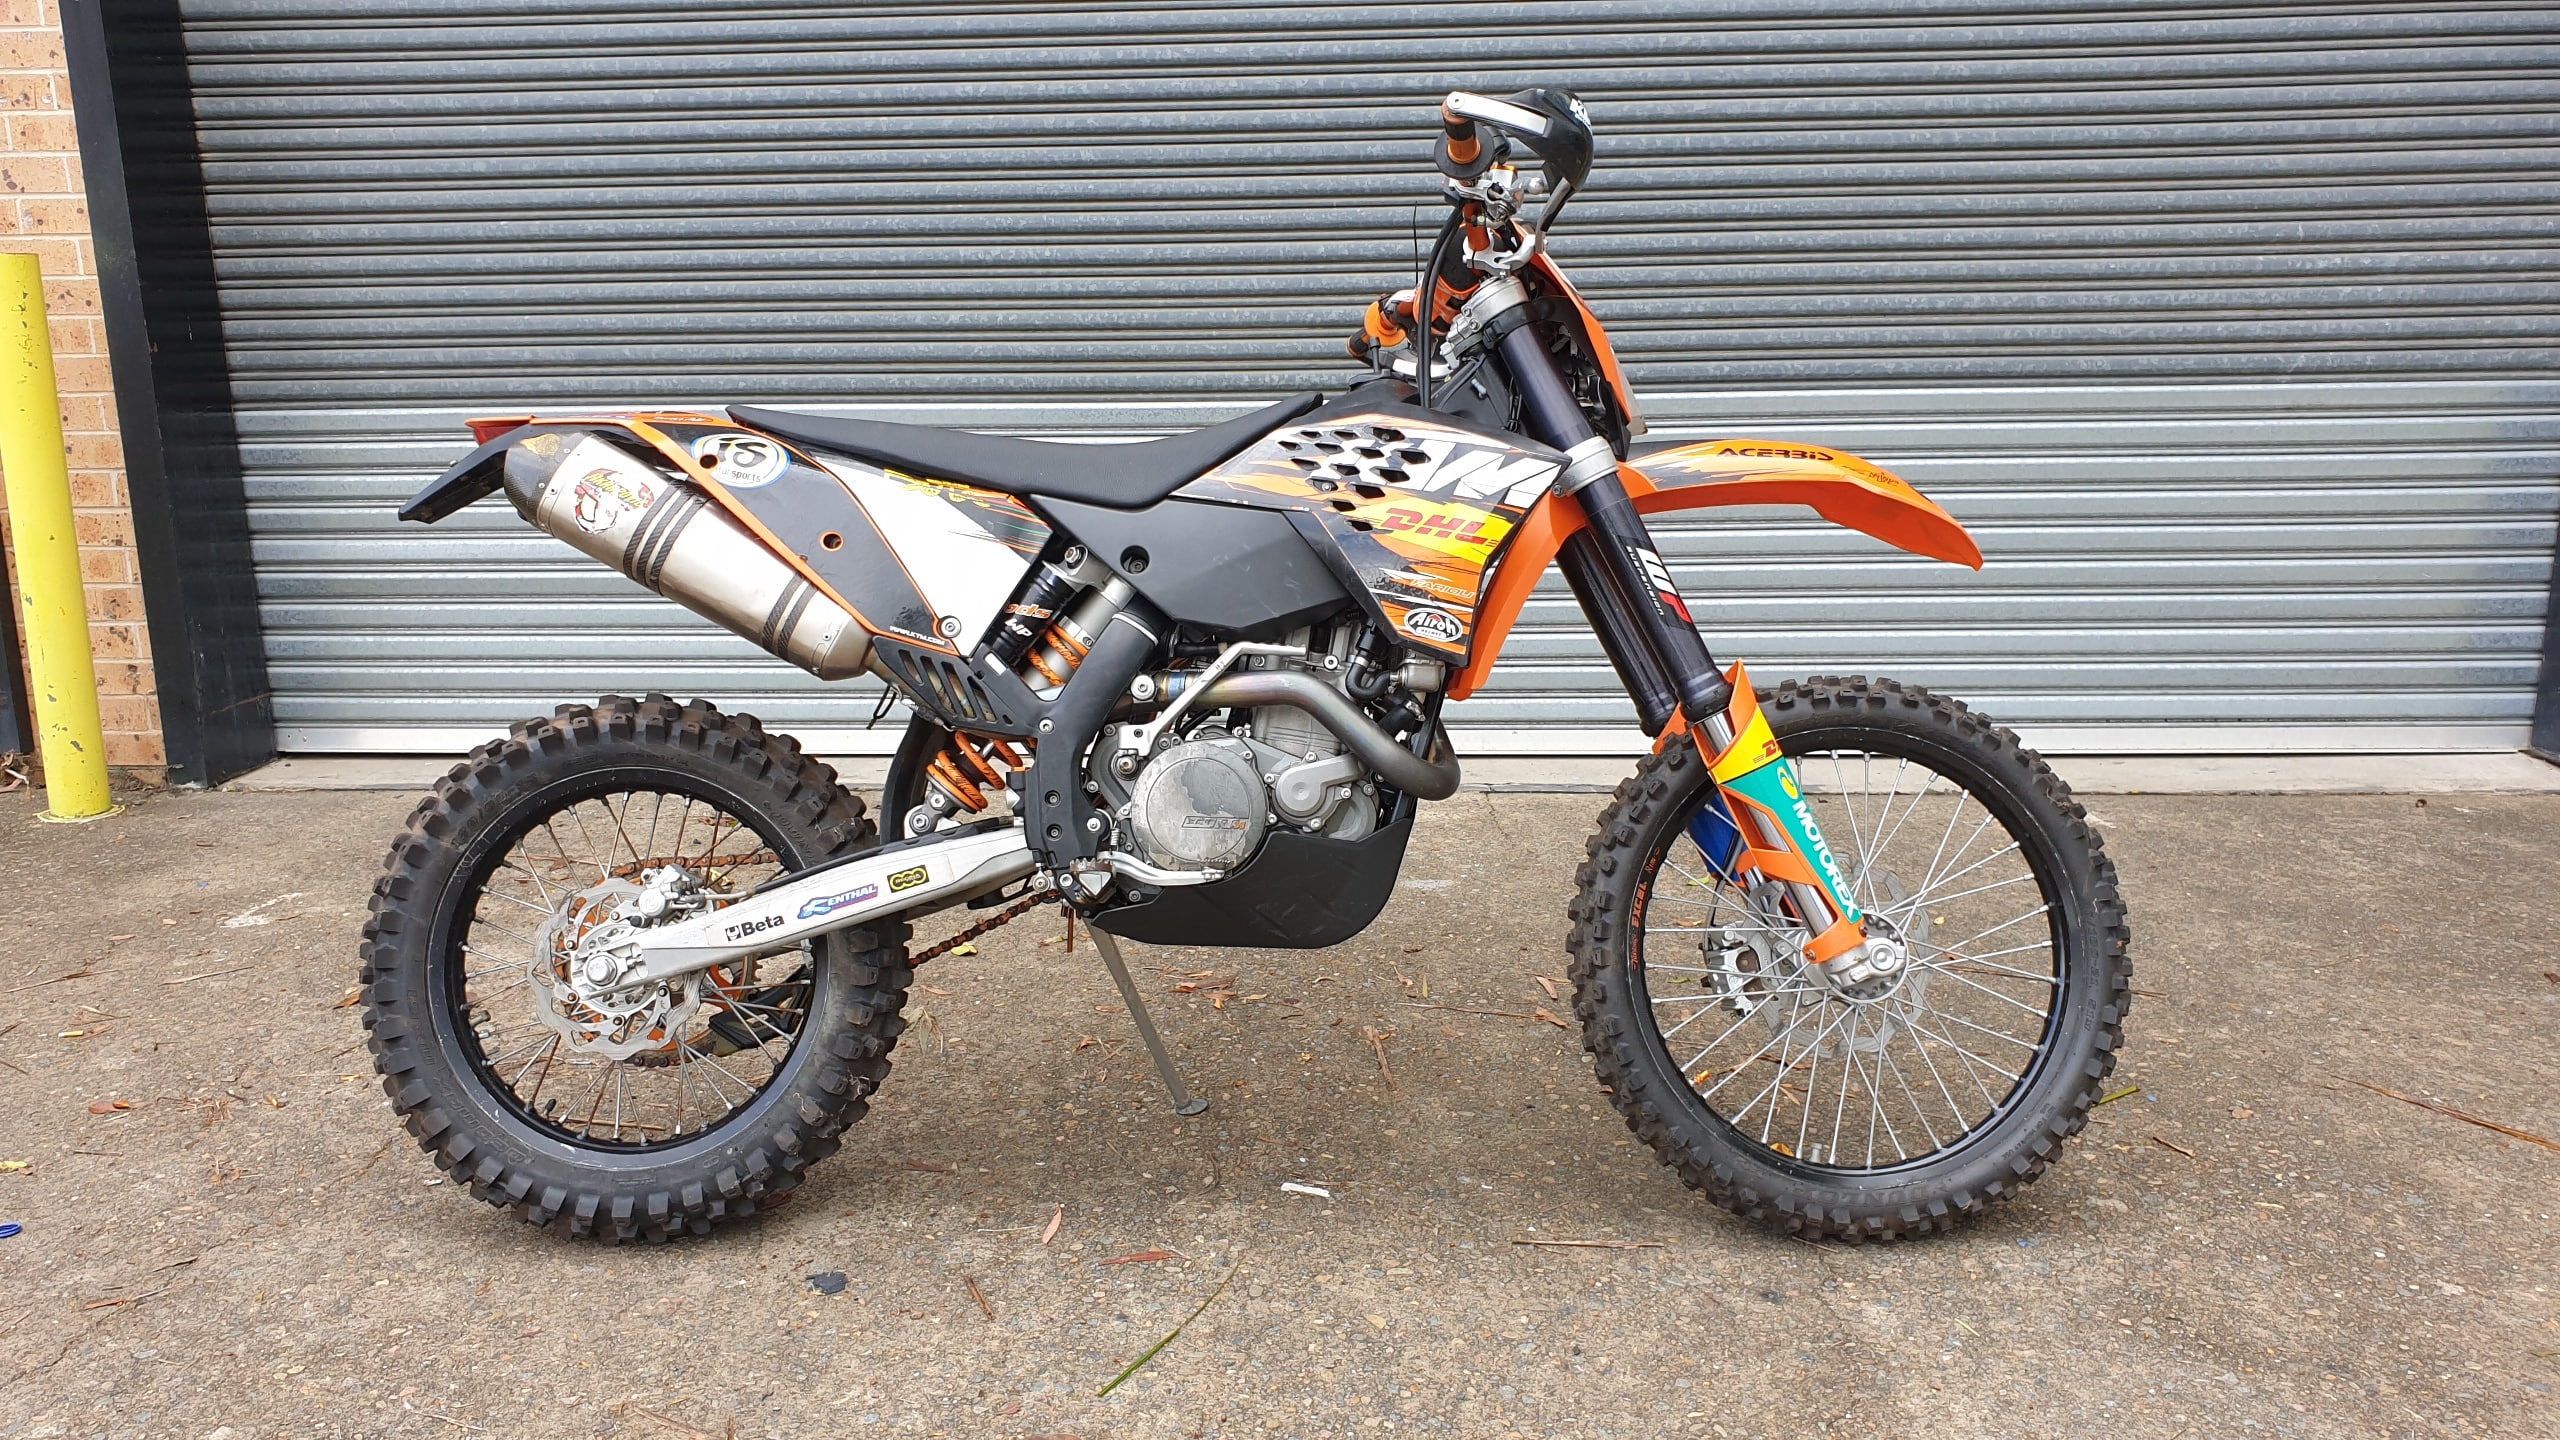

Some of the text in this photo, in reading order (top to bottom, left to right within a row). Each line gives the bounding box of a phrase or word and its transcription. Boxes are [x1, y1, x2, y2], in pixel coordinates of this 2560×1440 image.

[1380, 507, 1488, 545] DHL
[1408, 612, 1457, 636] Airoh
[1792, 799, 1859, 919] MOTOREX
[1631, 882, 1648, 928] EXCEL
[741, 914, 785, 937] Beta
